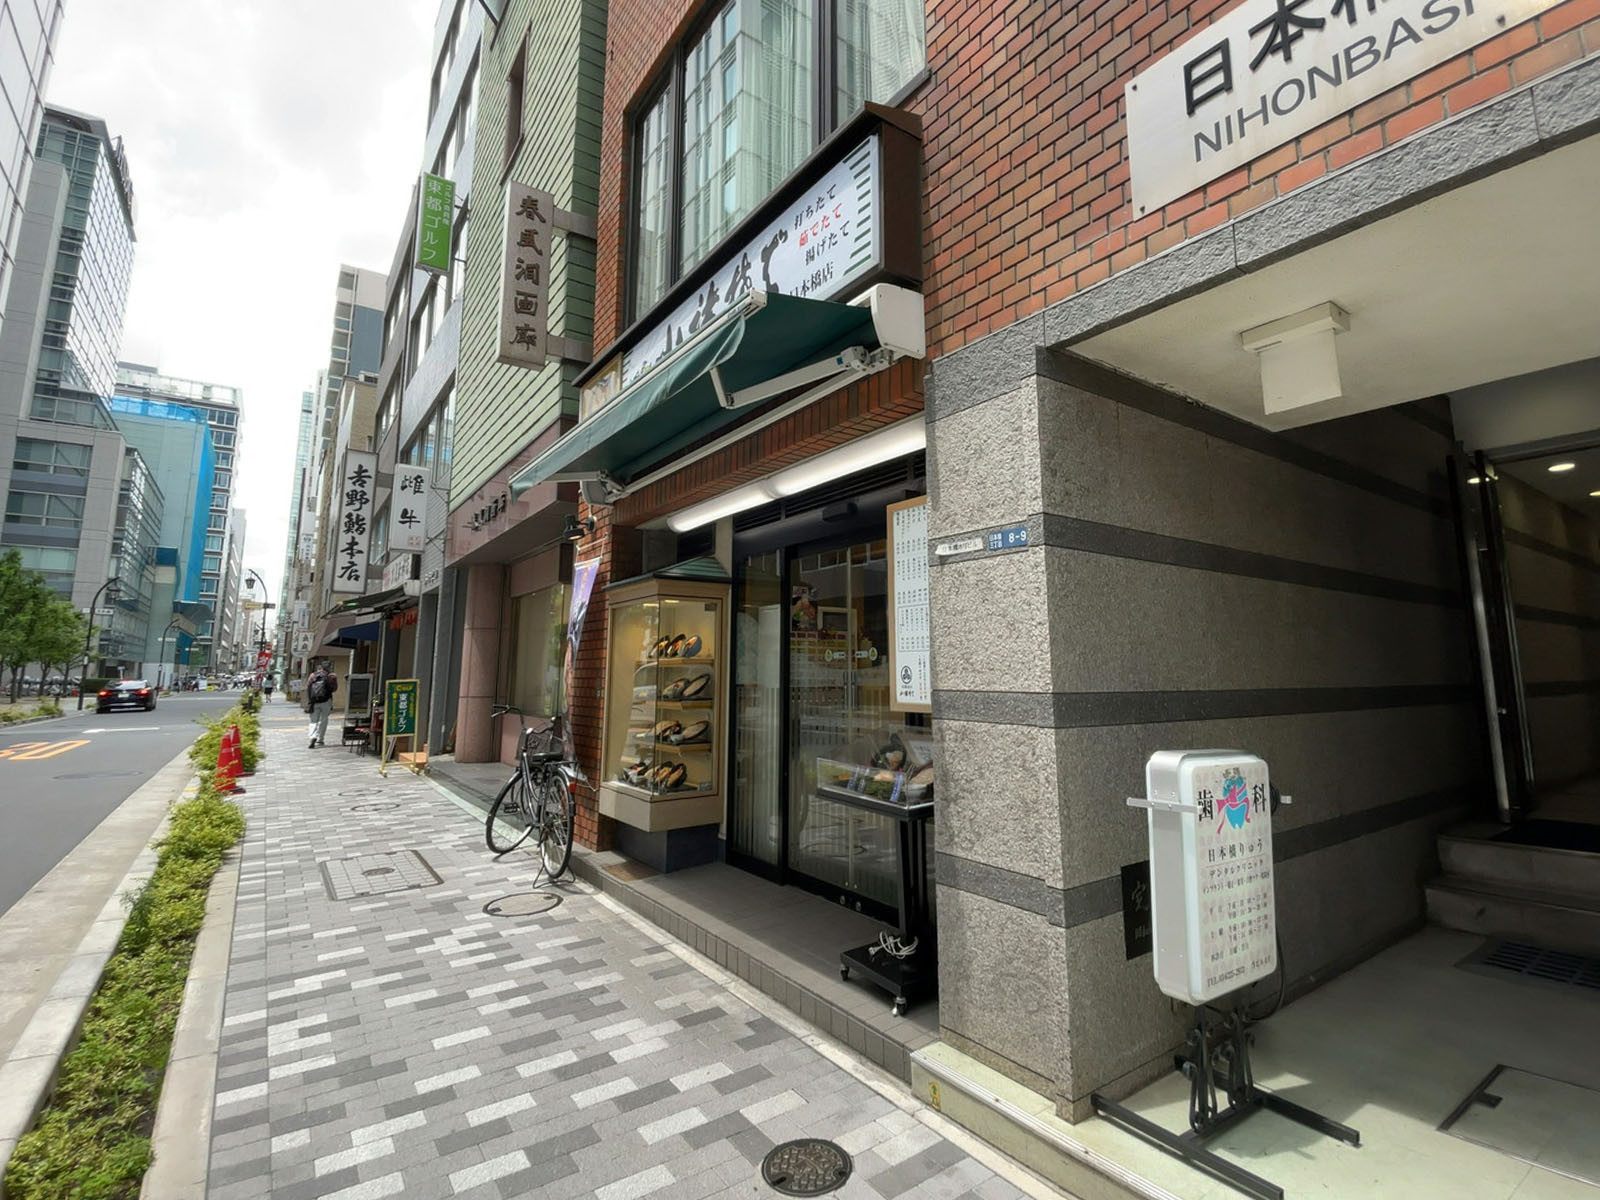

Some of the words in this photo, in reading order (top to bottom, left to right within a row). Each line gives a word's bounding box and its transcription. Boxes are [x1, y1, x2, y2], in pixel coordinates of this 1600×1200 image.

[423, 179, 444, 261] 東都ゴルフ
[794, 184, 837, 230] 打ちたて
[798, 202, 843, 249] 茹でたて
[804, 220, 850, 266] 揚げたて
[509, 194, 547, 352] 春風洞画廊
[337, 463, 373, 583] 吉野鮨本店
[1008, 530, 1027, 543] 8-9
[1197, 789, 1214, 822] 歯
[1252, 783, 1267, 813] 科
[1208, 838, 1263, 862] 日本橋りゅう
